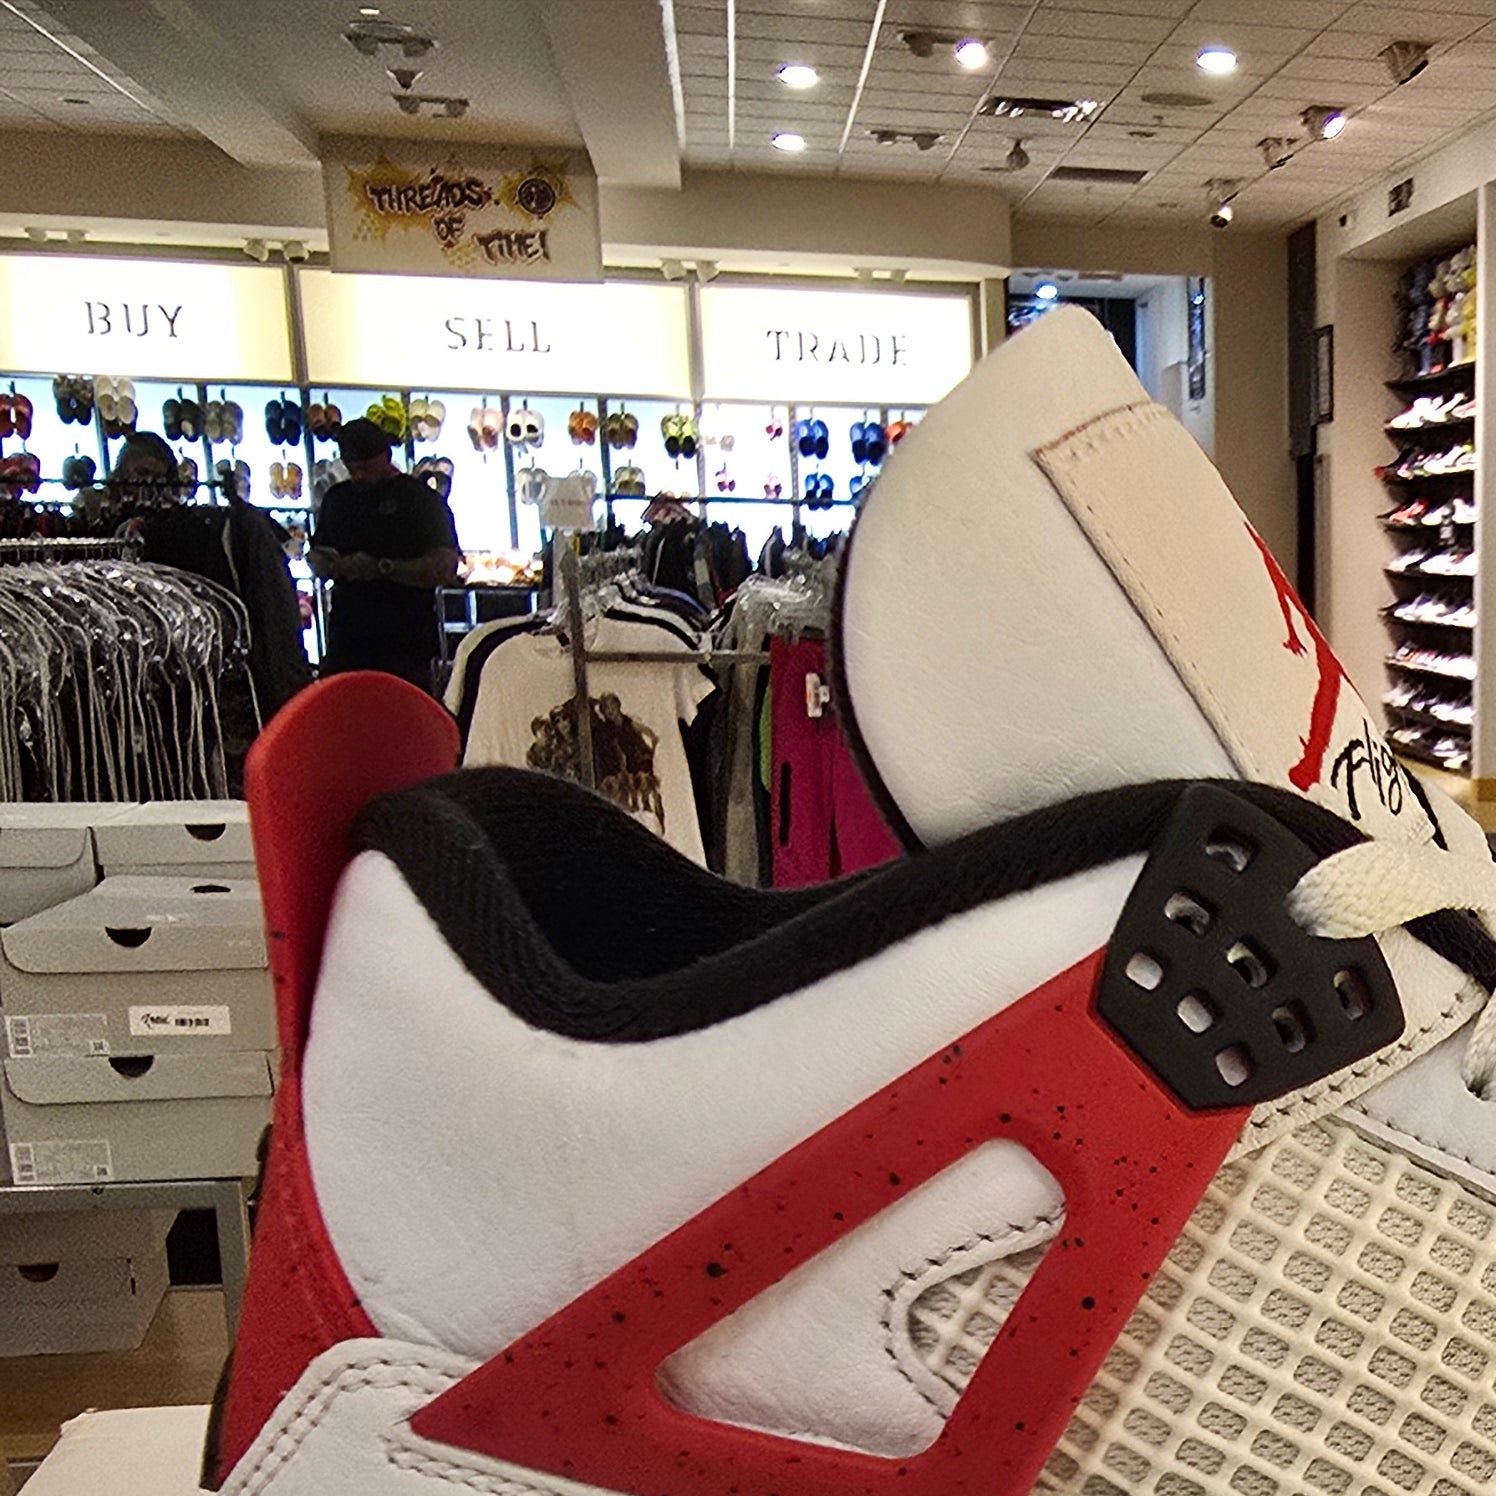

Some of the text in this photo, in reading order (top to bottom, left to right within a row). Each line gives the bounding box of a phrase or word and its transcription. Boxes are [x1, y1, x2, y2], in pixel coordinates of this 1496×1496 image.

[84, 301, 183, 338] BUY
[444, 317, 551, 353] SELL
[766, 330, 907, 366] TRADE
